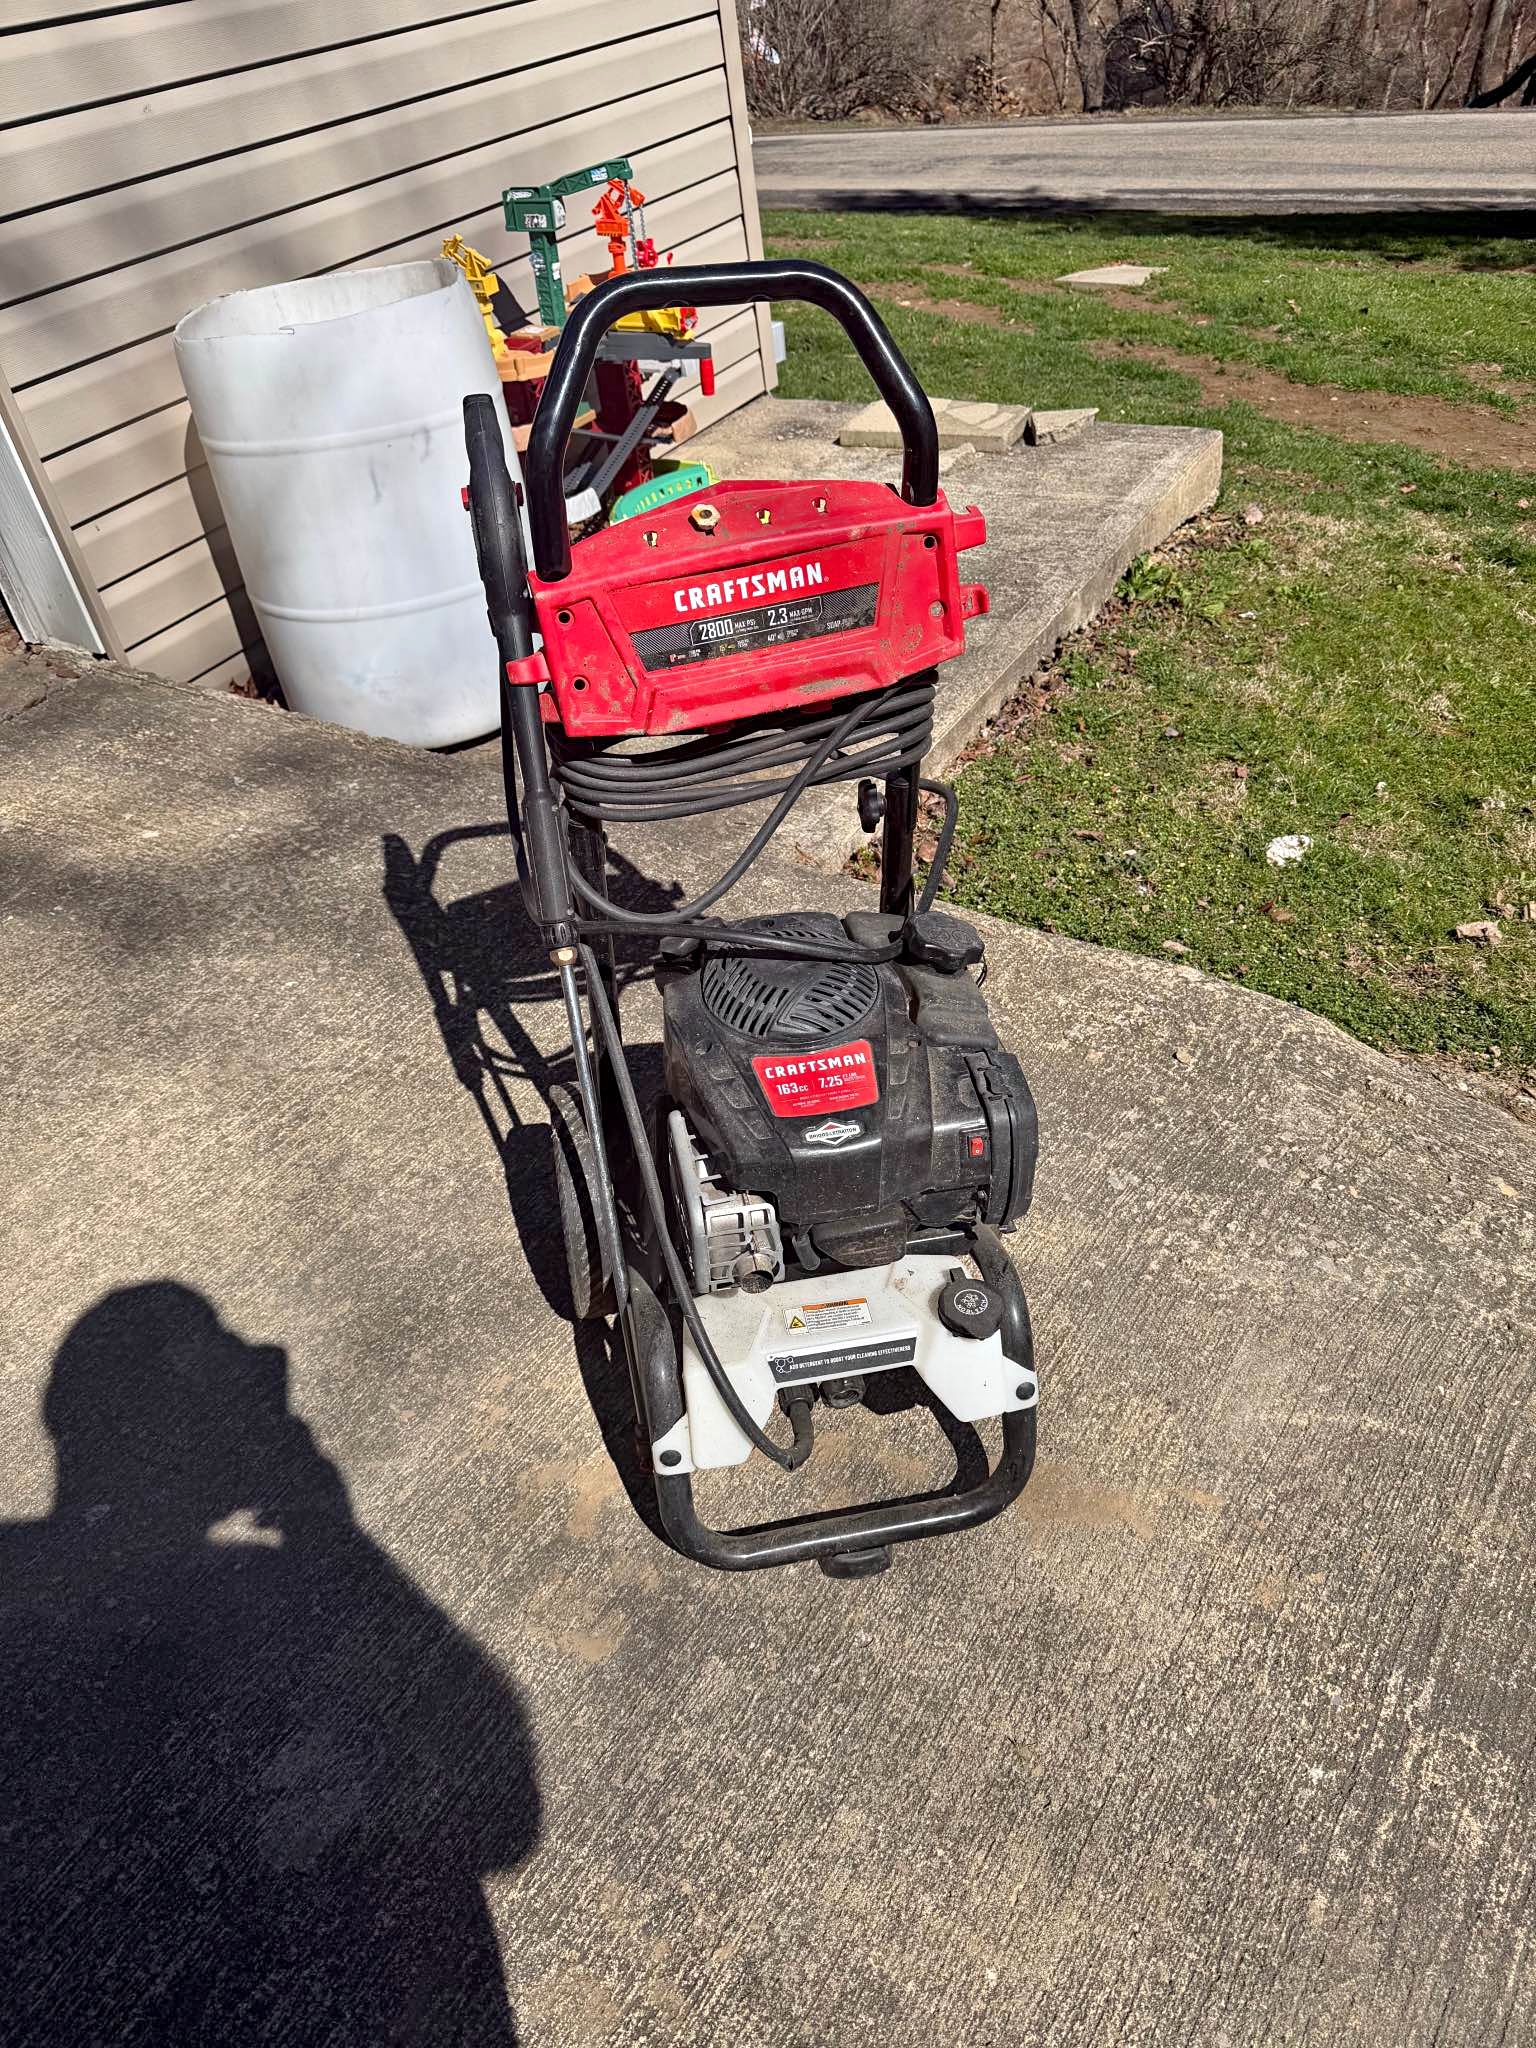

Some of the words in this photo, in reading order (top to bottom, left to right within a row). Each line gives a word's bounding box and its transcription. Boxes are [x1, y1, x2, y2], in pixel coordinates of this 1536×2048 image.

[673, 561, 823, 613] CRAFTSMAN
[767, 607, 789, 627] 2.3
[698, 618, 734, 642] 2800
[764, 1052, 867, 1079] CRAFTSMAN
[818, 1075, 843, 1089] 7.25
